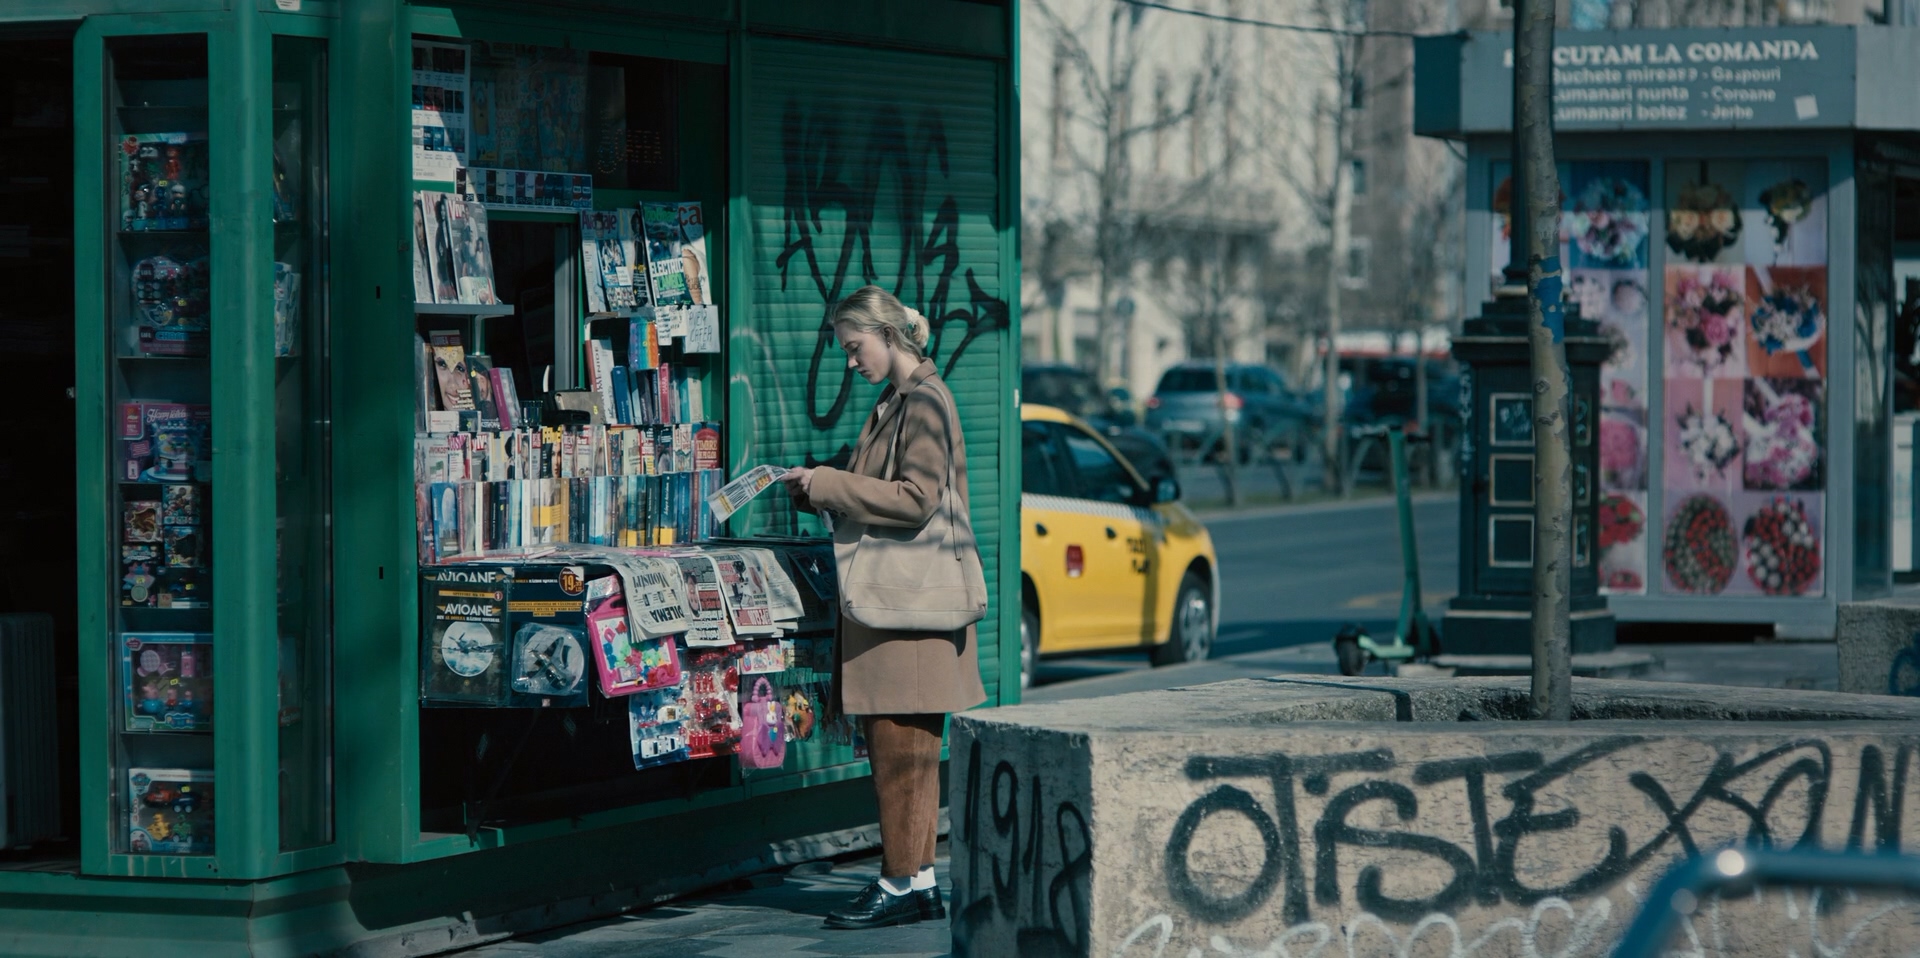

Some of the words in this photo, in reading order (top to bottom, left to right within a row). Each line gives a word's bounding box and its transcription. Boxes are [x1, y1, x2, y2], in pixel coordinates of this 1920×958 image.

[1646, 43, 1682, 64] LA
[1686, 39, 1820, 64] COMANDA
[1636, 86, 1690, 102] nunta
[1636, 103, 1688, 121] botez
[444, 602, 493, 617] AVIOANE
[649, 605, 685, 623] DILEMA
